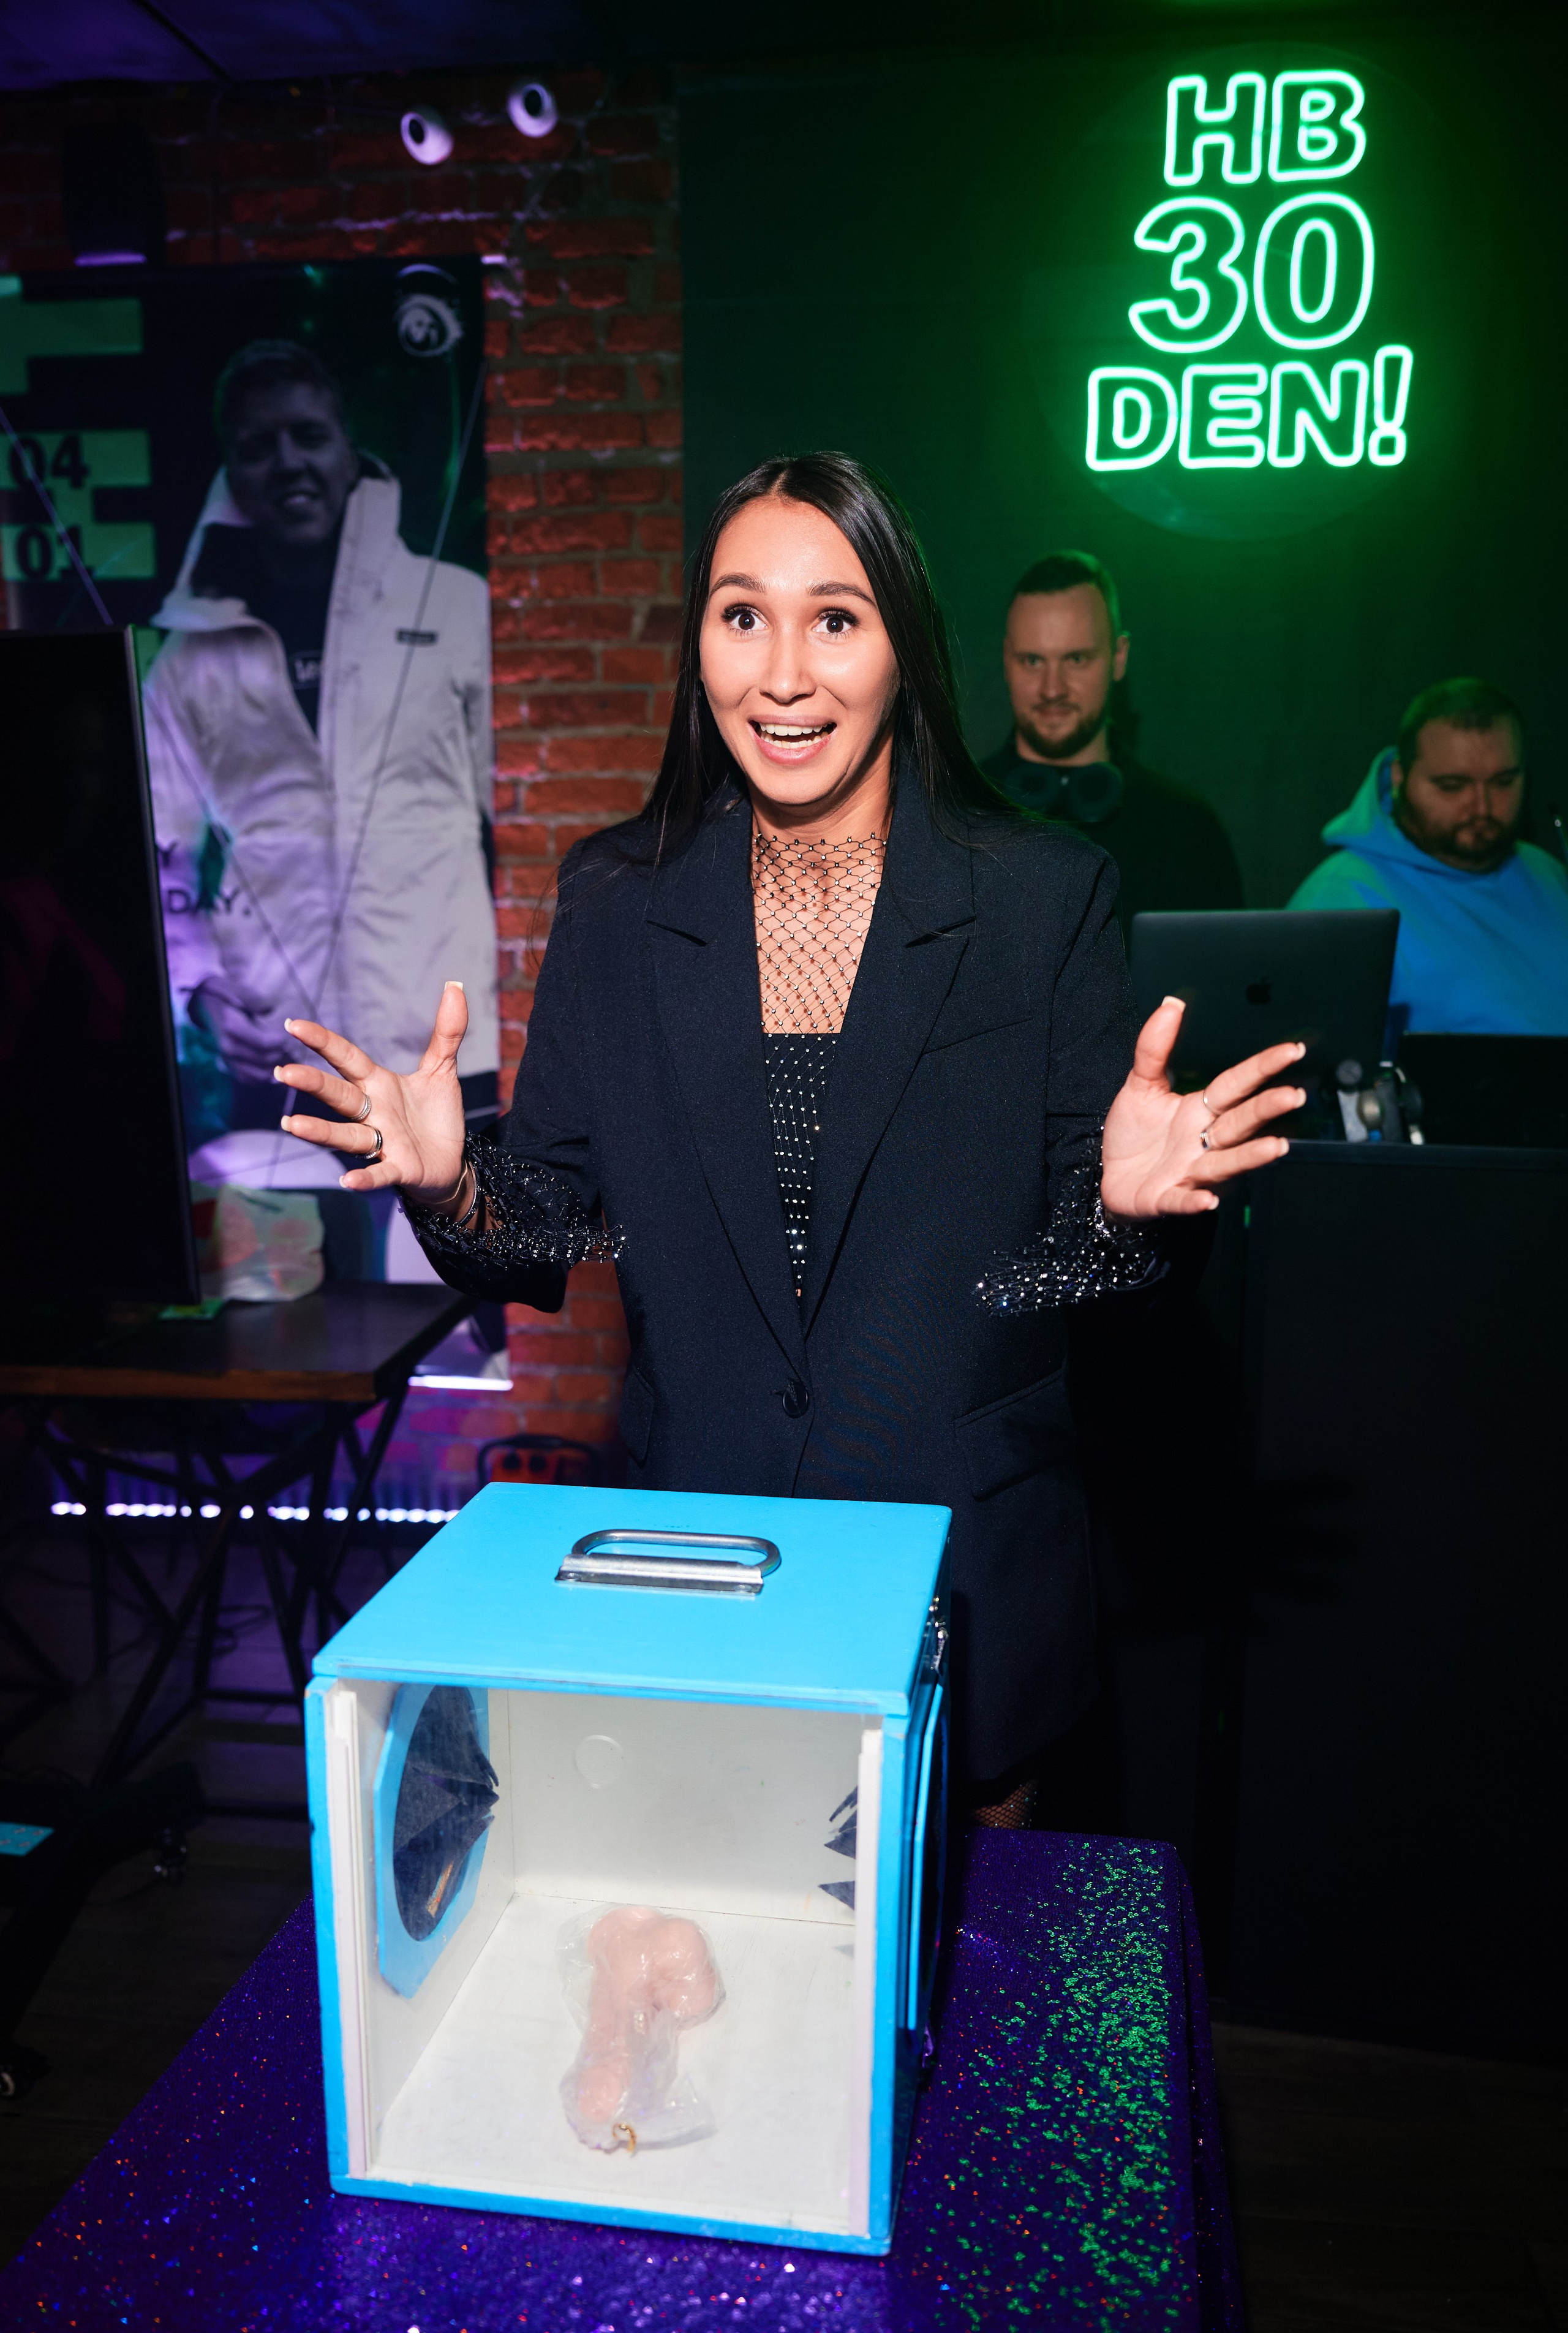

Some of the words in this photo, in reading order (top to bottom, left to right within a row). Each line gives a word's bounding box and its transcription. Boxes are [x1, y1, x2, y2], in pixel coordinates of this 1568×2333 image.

[1163, 69, 1366, 187] HB
[1128, 191, 1375, 354] 30
[10, 435, 89, 491] 04
[1085, 345, 1414, 472] DEN!
[17, 527, 93, 579] 01
